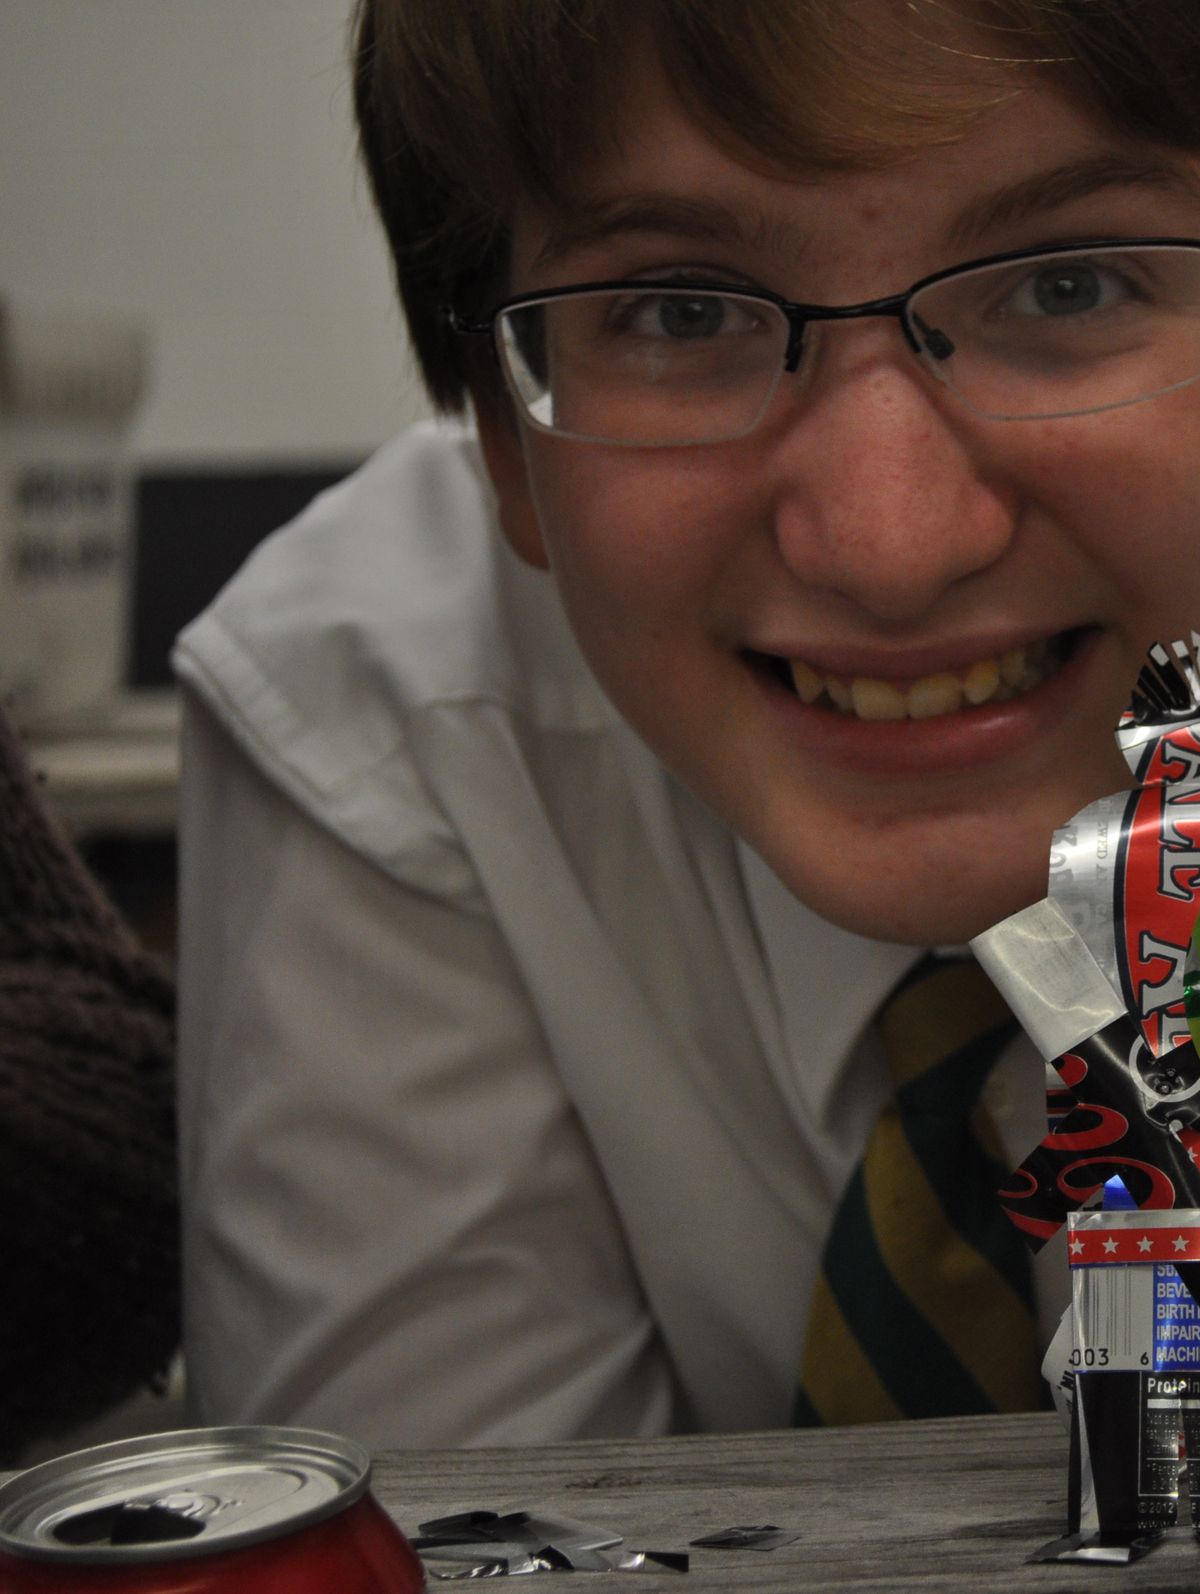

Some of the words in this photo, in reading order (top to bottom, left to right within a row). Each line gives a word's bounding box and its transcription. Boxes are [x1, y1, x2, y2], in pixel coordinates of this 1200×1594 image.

[1156, 1303, 1195, 1320] BIRTH
[1140, 1351, 1150, 1366] 6
[1147, 1377, 1200, 1394] Protein
